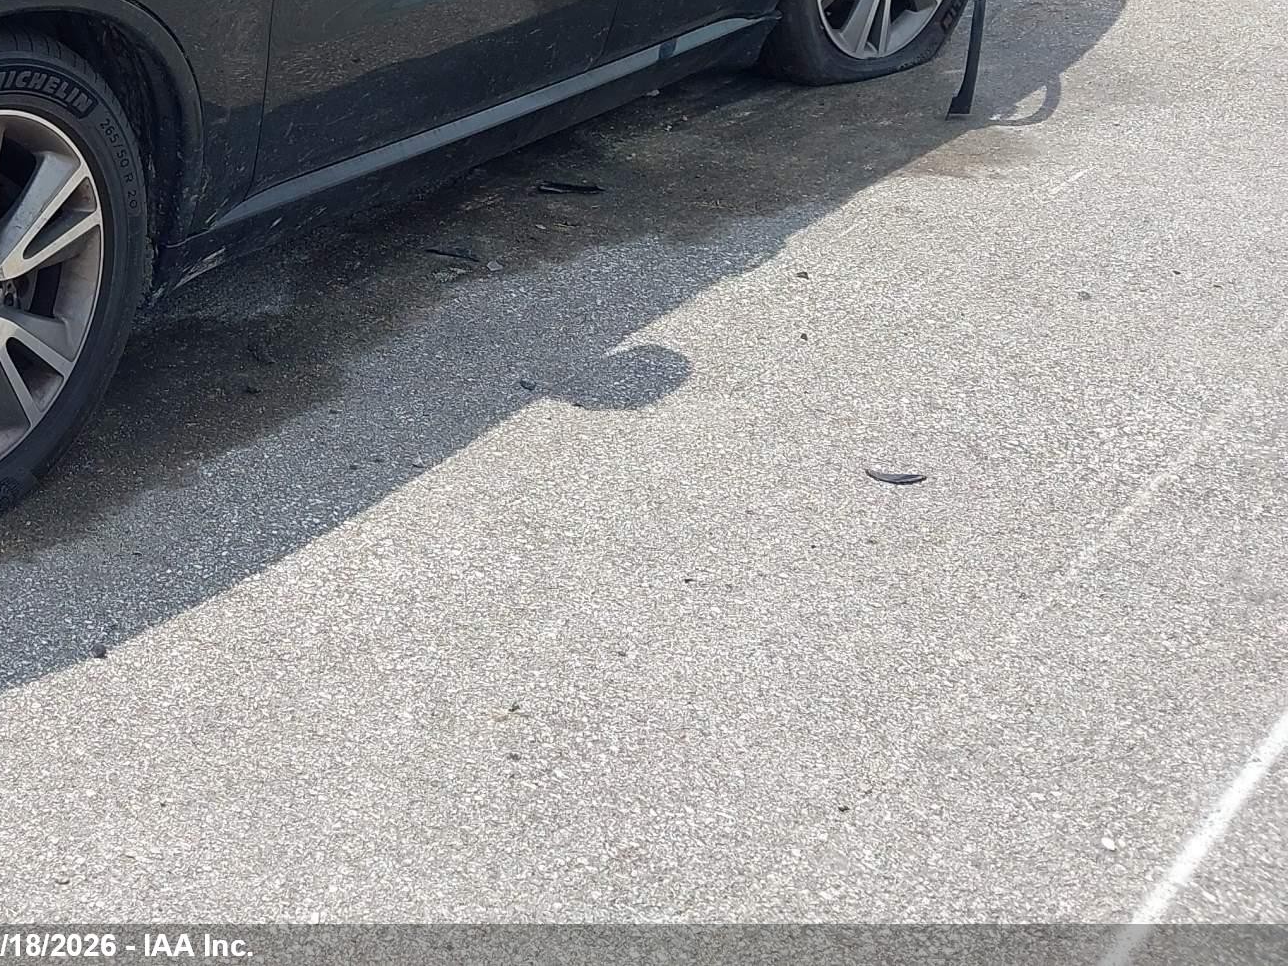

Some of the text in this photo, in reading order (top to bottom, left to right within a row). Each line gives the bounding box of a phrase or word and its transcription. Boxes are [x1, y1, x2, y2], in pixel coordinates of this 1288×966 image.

[98, 118, 138, 210] 265/50 R 20
